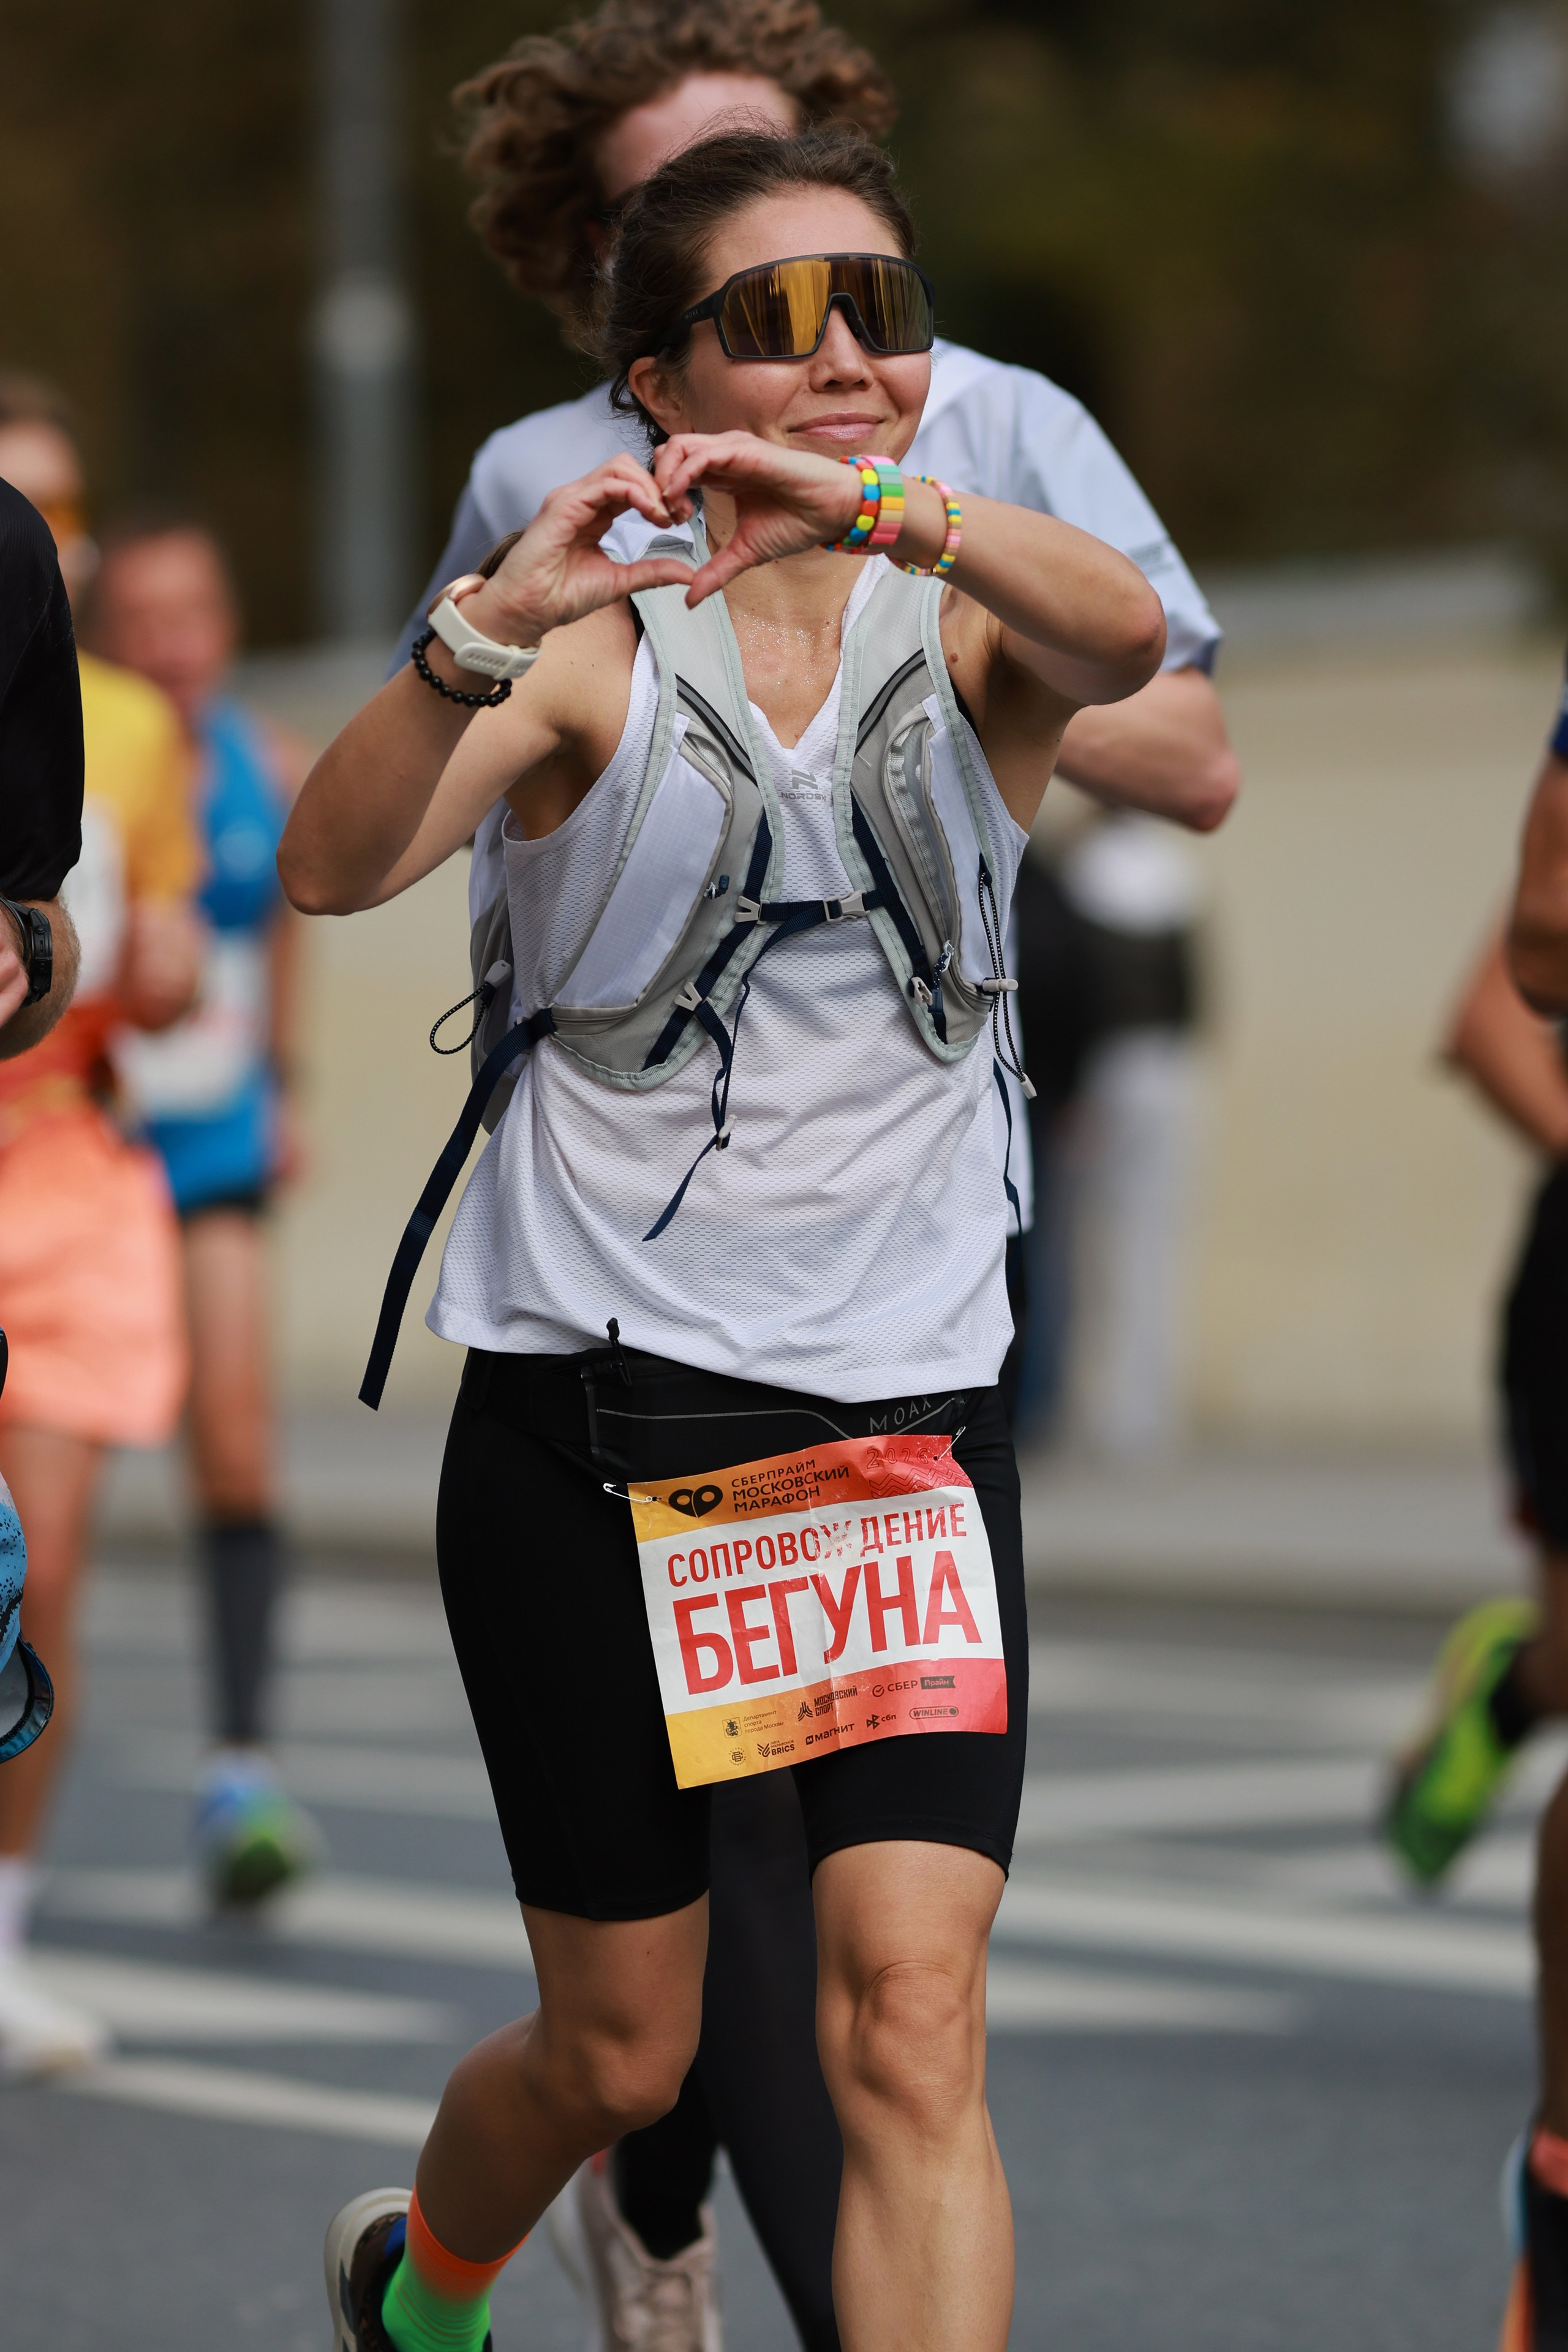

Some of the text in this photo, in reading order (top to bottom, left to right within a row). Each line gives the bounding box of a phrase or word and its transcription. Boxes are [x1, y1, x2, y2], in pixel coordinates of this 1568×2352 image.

[869, 1395, 931, 1433] MOAX
[867, 1447, 929, 1469] 2026
[731, 1460, 816, 1488] СБЕРПРАЙМ
[733, 1465, 850, 1501] МОСКОВСКИЙ
[734, 1485, 820, 1513] МАРАФОН
[673, 1550, 982, 1695] БЕГУНА
[814, 1685, 858, 1707] МОСКОВСКИЙ
[888, 1680, 918, 1692] СБЕР
[743, 1711, 777, 1722] Департамент
[815, 1702, 834, 1716] СПОРТ
[913, 1708, 948, 1717] WINLINE
[764, 1721, 784, 1730] Москвы
[771, 1744, 795, 1755] BRICS
